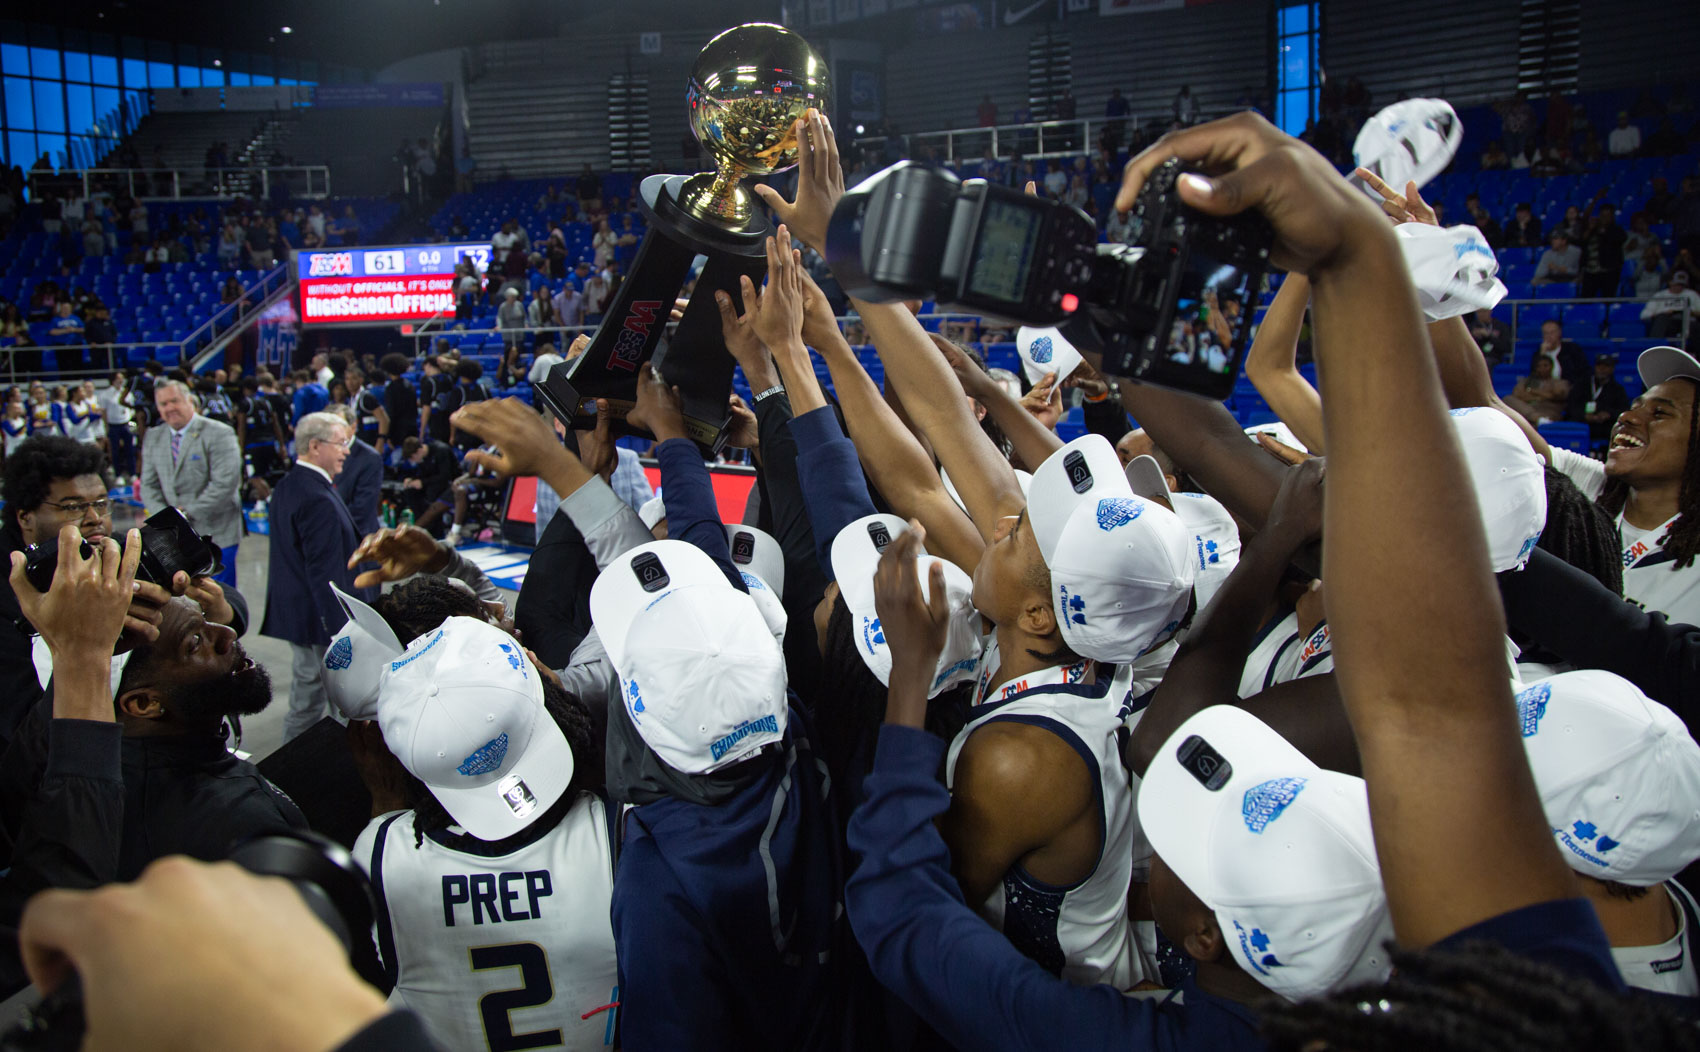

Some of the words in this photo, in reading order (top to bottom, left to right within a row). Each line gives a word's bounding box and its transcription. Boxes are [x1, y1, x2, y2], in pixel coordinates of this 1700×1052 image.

[308, 252, 353, 276] TSSAA
[374, 255, 396, 270] 61
[418, 251, 441, 265] 0.0
[307, 283, 352, 295] WITHOUT
[353, 281, 406, 294] OFFICIALS,
[408, 280, 427, 291] IT'S
[428, 279, 454, 291] ONLY
[606, 300, 664, 373] TSSAA
[1621, 541, 1648, 571] SSAA
[710, 714, 779, 762] CHAMPIONS
[1561, 832, 1610, 867] Tennessee
[442, 869, 553, 927] PREP
[467, 941, 565, 1052] 2
